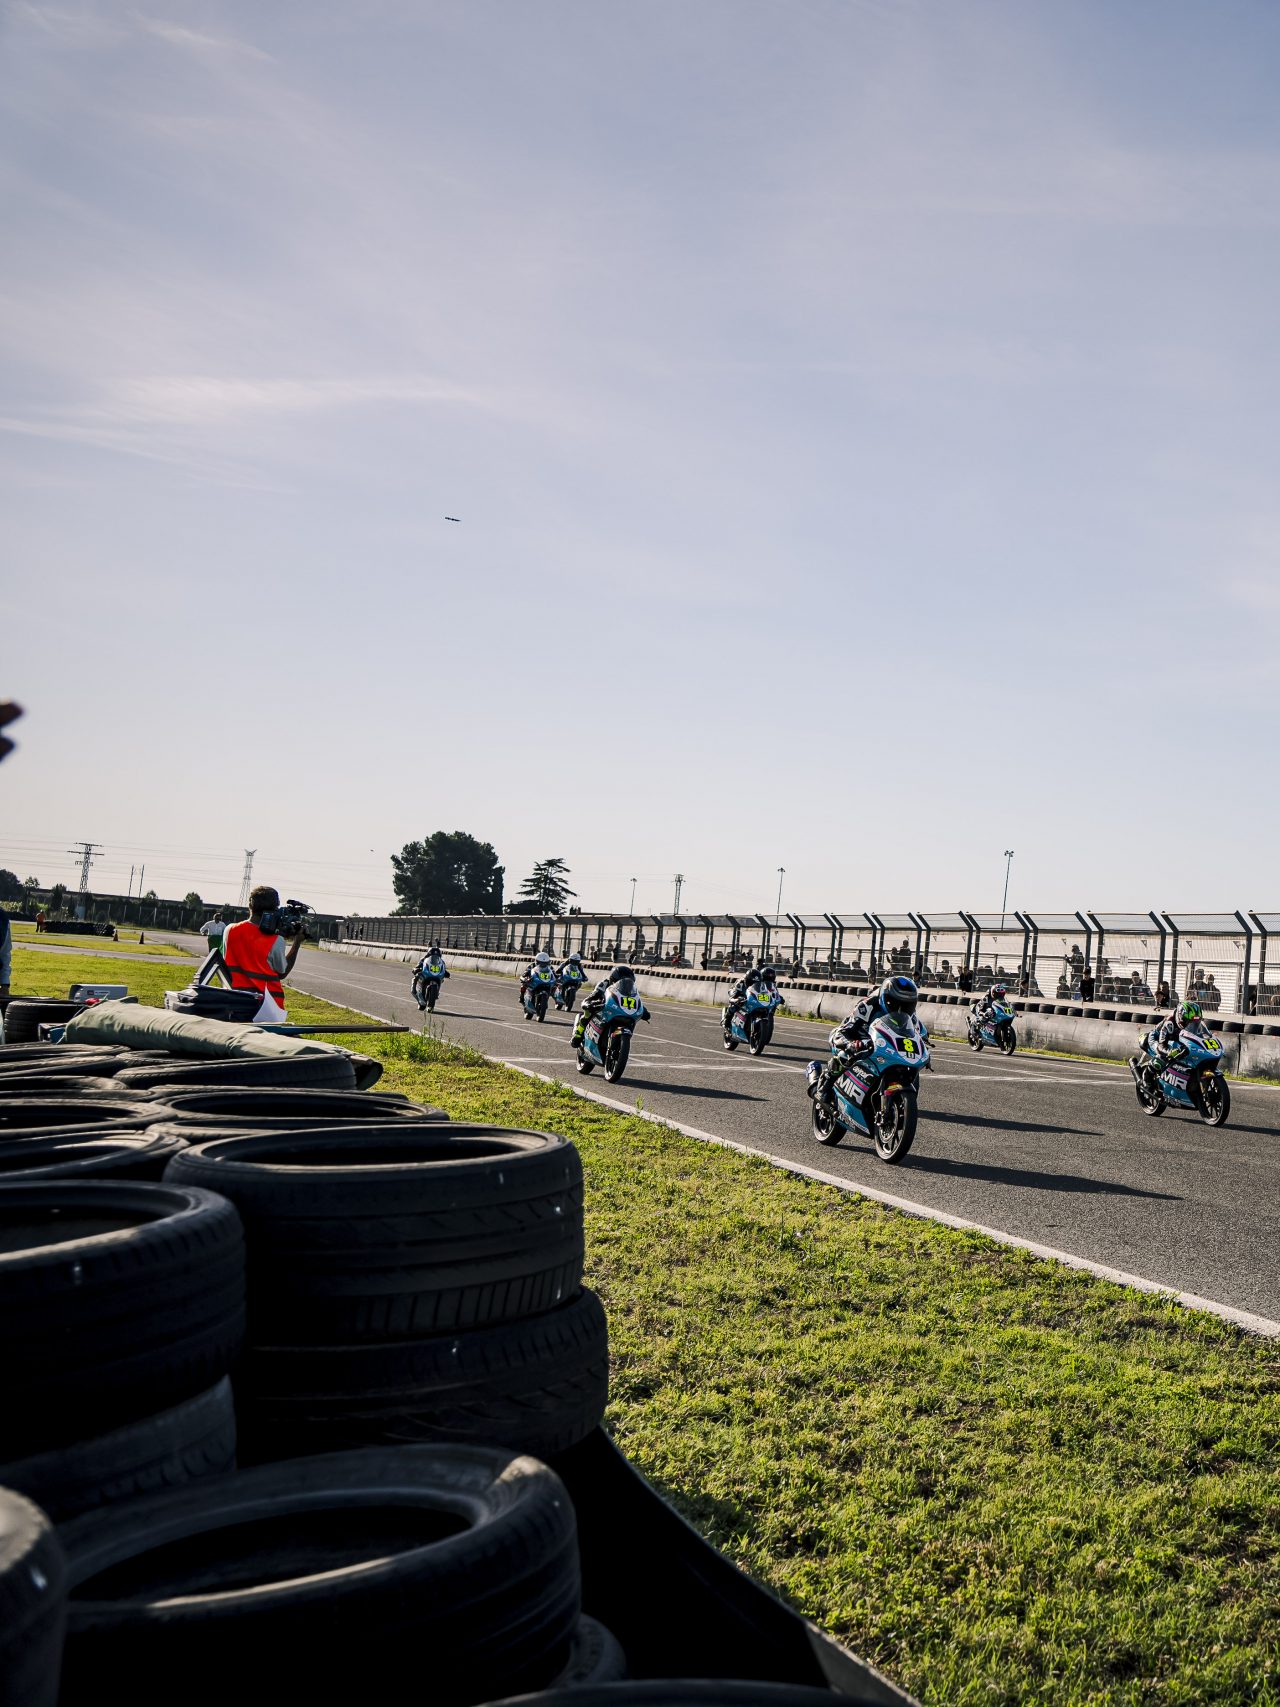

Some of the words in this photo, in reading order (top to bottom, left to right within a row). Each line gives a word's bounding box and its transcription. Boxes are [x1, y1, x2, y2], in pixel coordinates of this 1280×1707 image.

[621, 997, 636, 1008] 17
[903, 1038, 914, 1053] 8
[1205, 1039, 1219, 1050] 13
[1160, 1070, 1188, 1091] MIR
